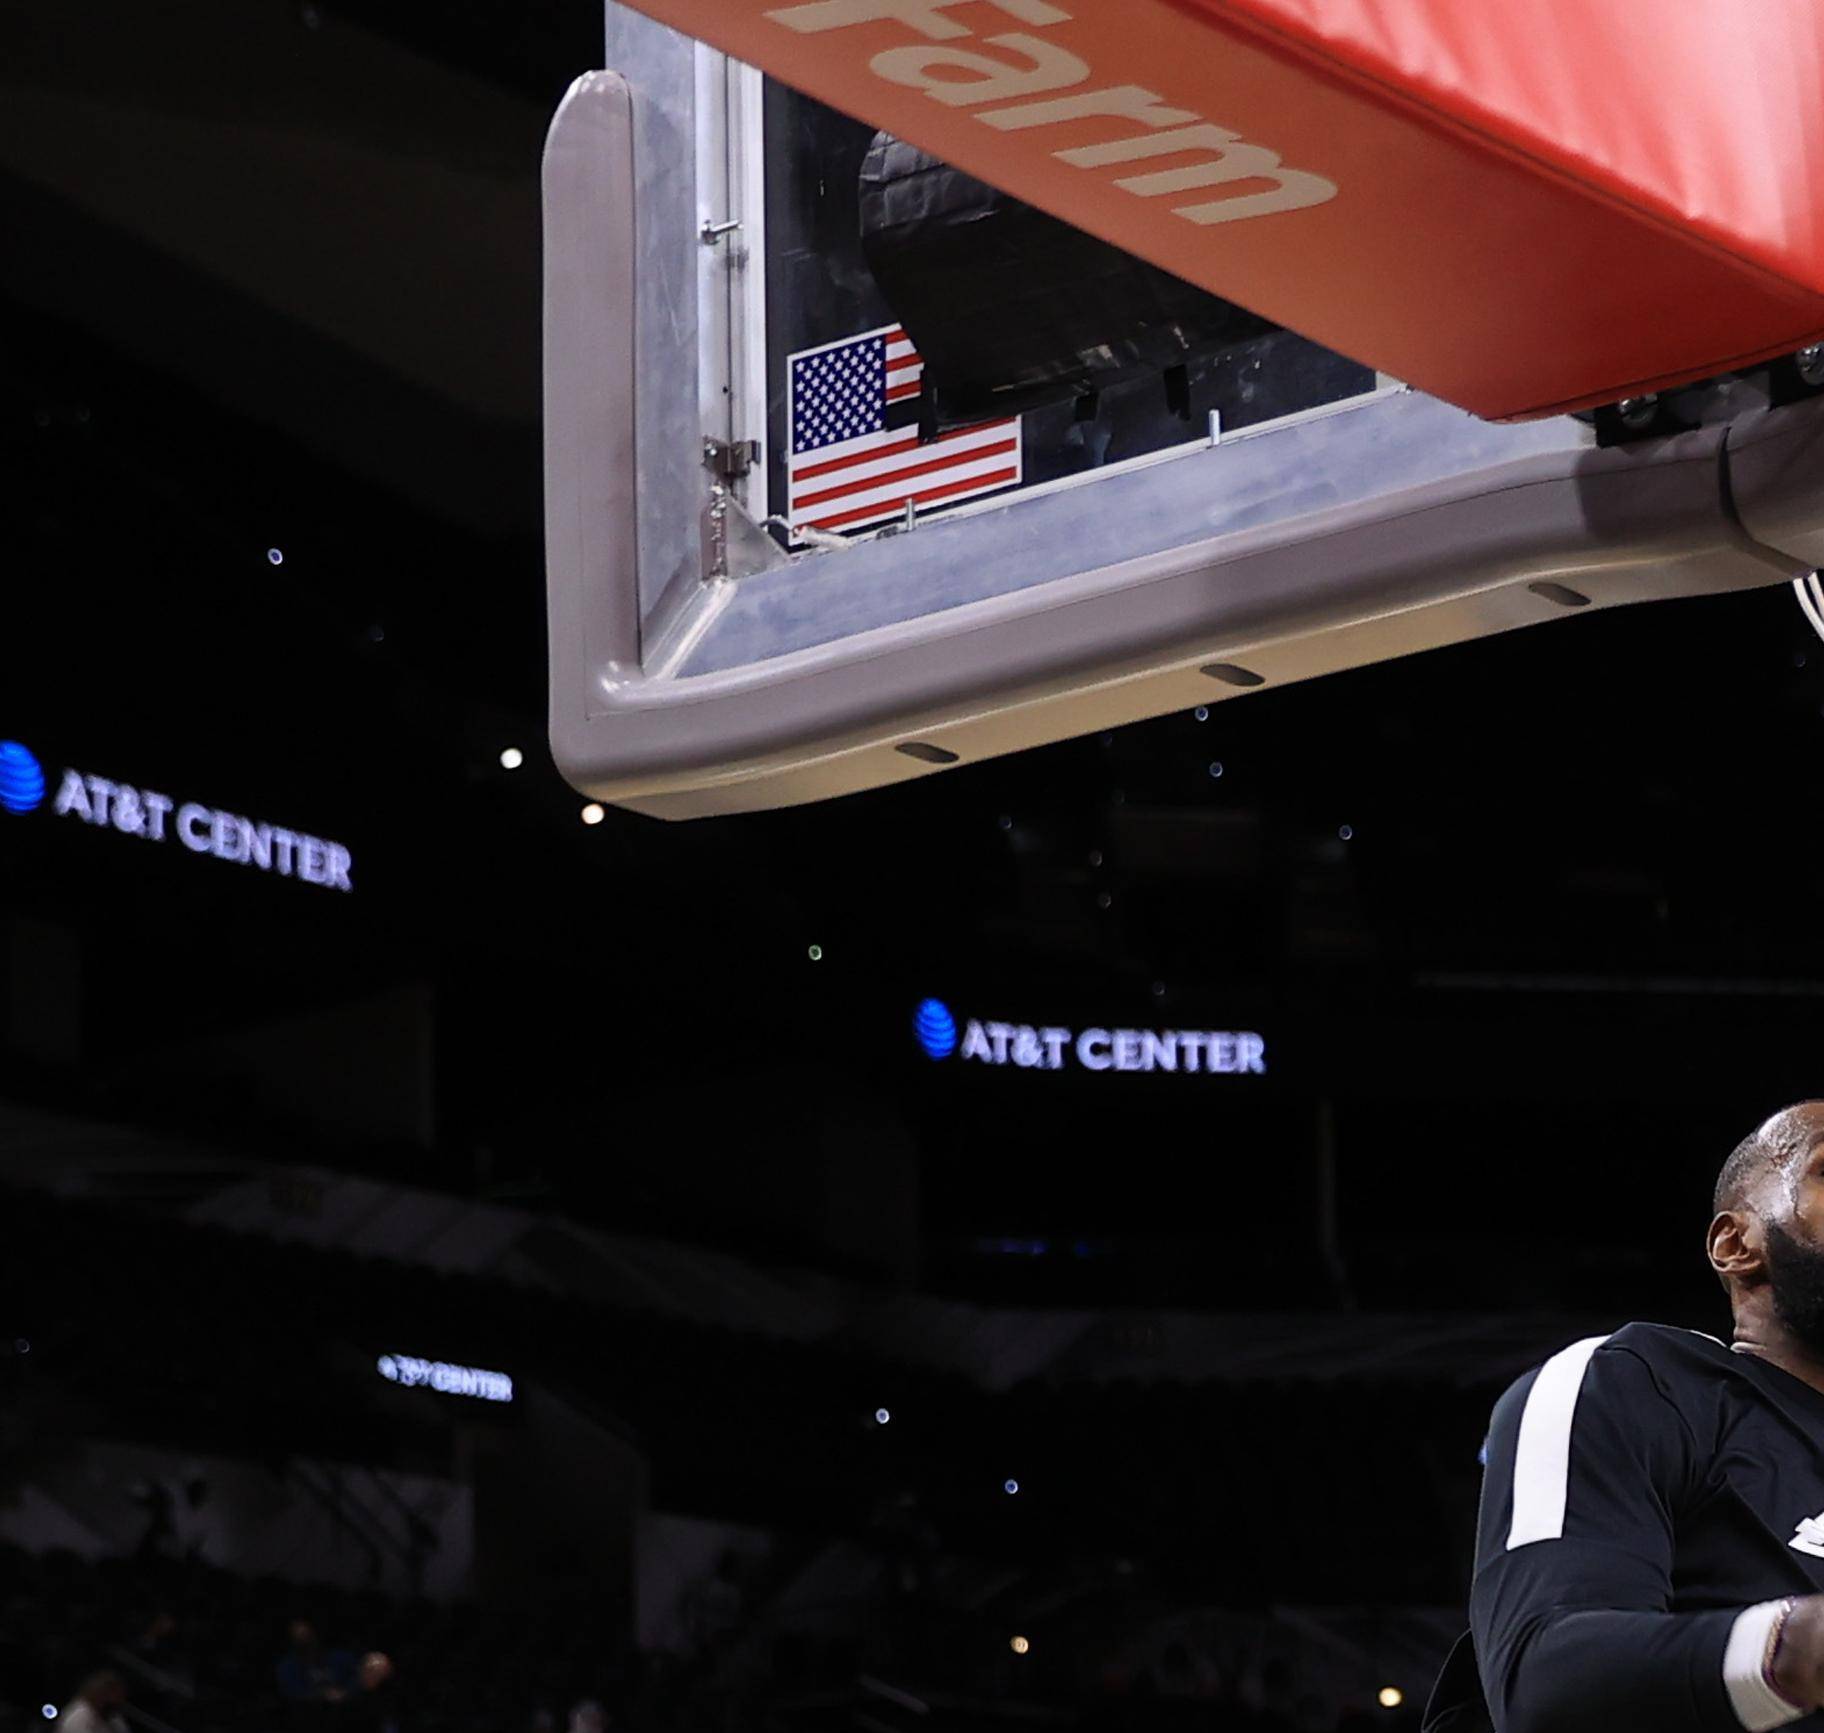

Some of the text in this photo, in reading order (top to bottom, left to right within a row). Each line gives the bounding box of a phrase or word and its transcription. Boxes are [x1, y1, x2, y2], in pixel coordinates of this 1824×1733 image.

[55, 768, 353, 892] AT&T CENTER
[961, 1018, 1266, 1075] AT&T CENTER
